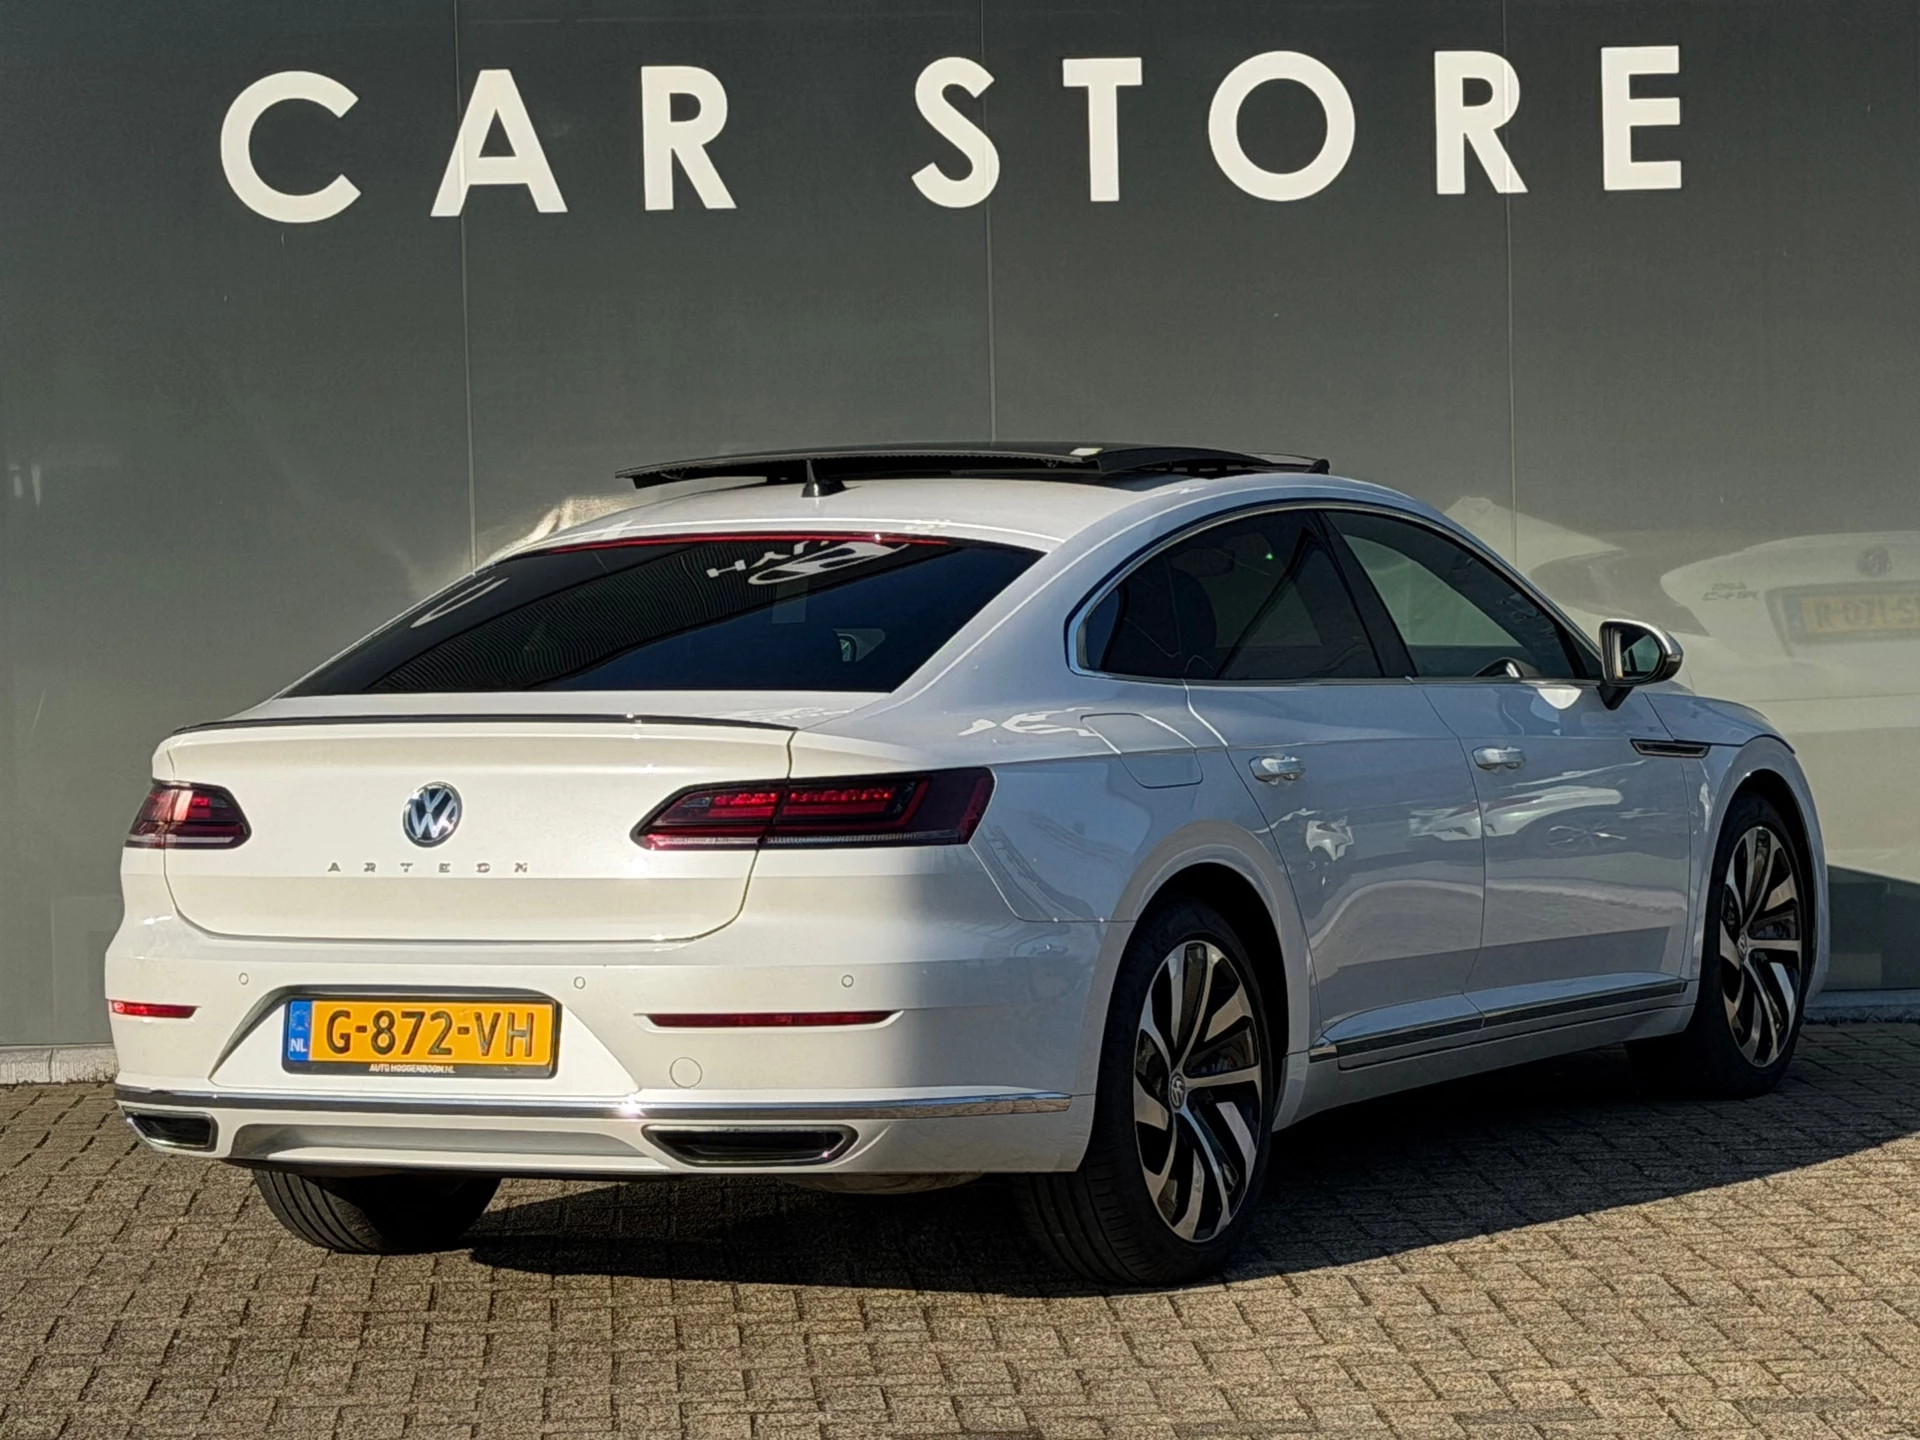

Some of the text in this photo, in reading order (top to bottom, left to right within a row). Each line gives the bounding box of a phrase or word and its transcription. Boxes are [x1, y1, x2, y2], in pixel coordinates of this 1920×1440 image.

[220, 45, 1682, 224] CAR STORE
[327, 861, 528, 873] ARTEON
[326, 1010, 533, 1057] G-872-VH
[290, 1038, 308, 1052] NL
[369, 1063, 390, 1073] AUTO
